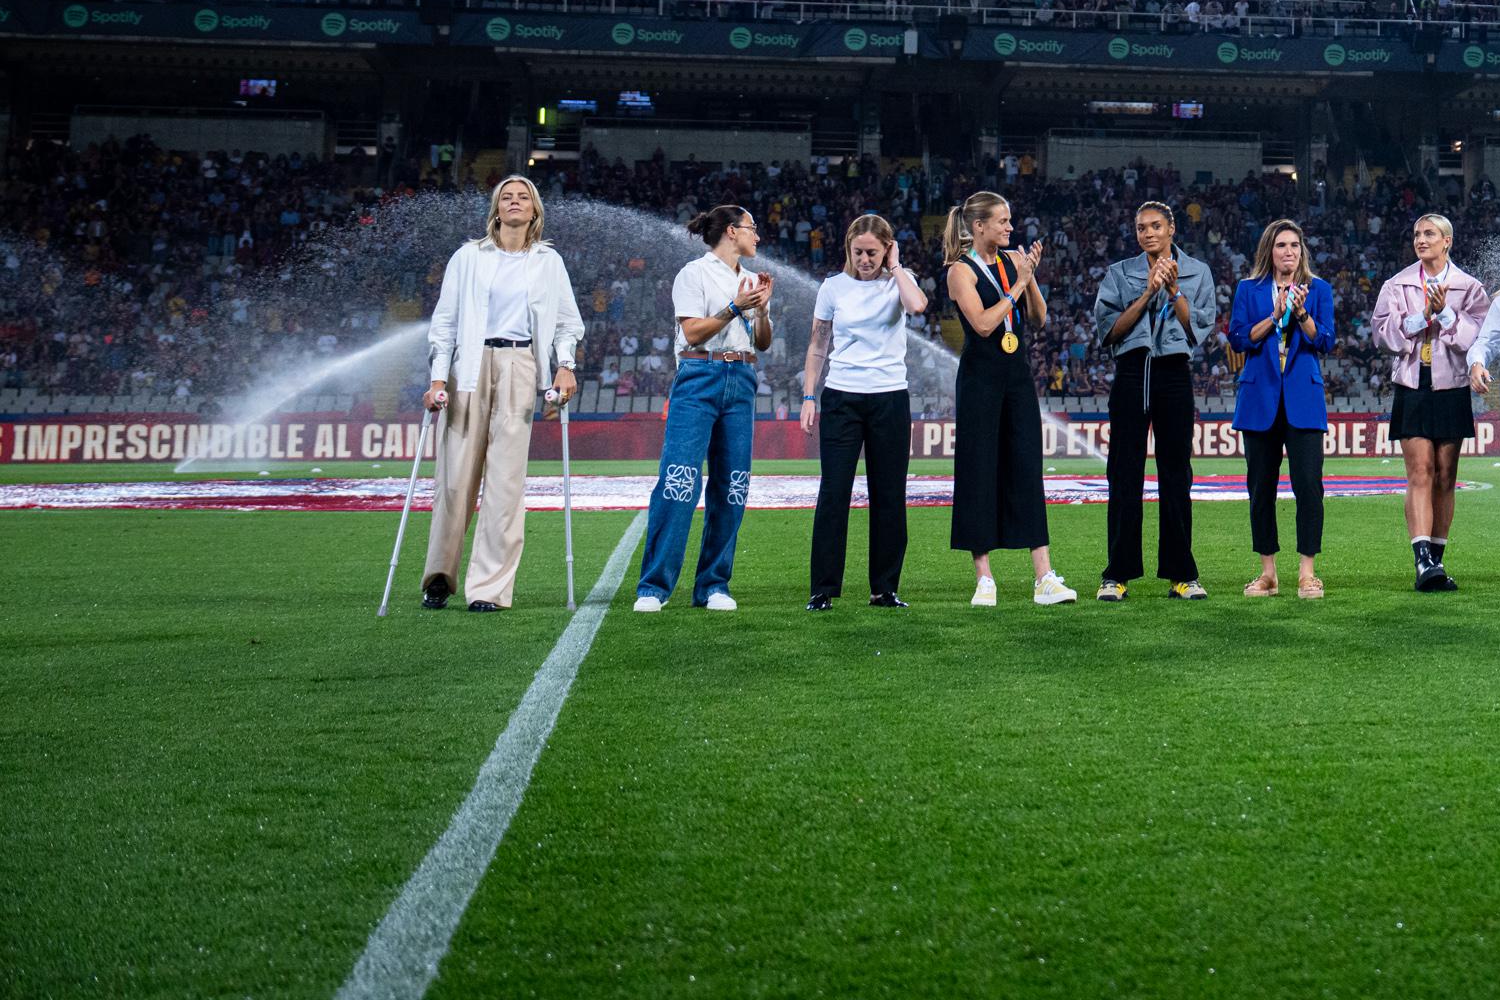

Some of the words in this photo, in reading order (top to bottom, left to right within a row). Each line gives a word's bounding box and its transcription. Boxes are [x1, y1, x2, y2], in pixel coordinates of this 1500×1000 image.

[90, 10, 143, 26] Spotify
[221, 13, 272, 31] Spotify
[350, 17, 400, 34] Spotify
[514, 23, 564, 41] Spotify
[636, 28, 684, 46] Spotify
[754, 32, 800, 49] Spotify
[870, 33, 904, 47] Spot
[1018, 39, 1065, 55] Spotify
[1131, 43, 1174, 59] Spotify
[1239, 48, 1282, 62] Spotify
[1346, 48, 1390, 63] Spotify
[11, 423, 306, 460] IMPRESCINDIBLE
[314, 423, 352, 458] AL
[361, 423, 436, 459] CAM
[923, 422, 956, 456] PE
